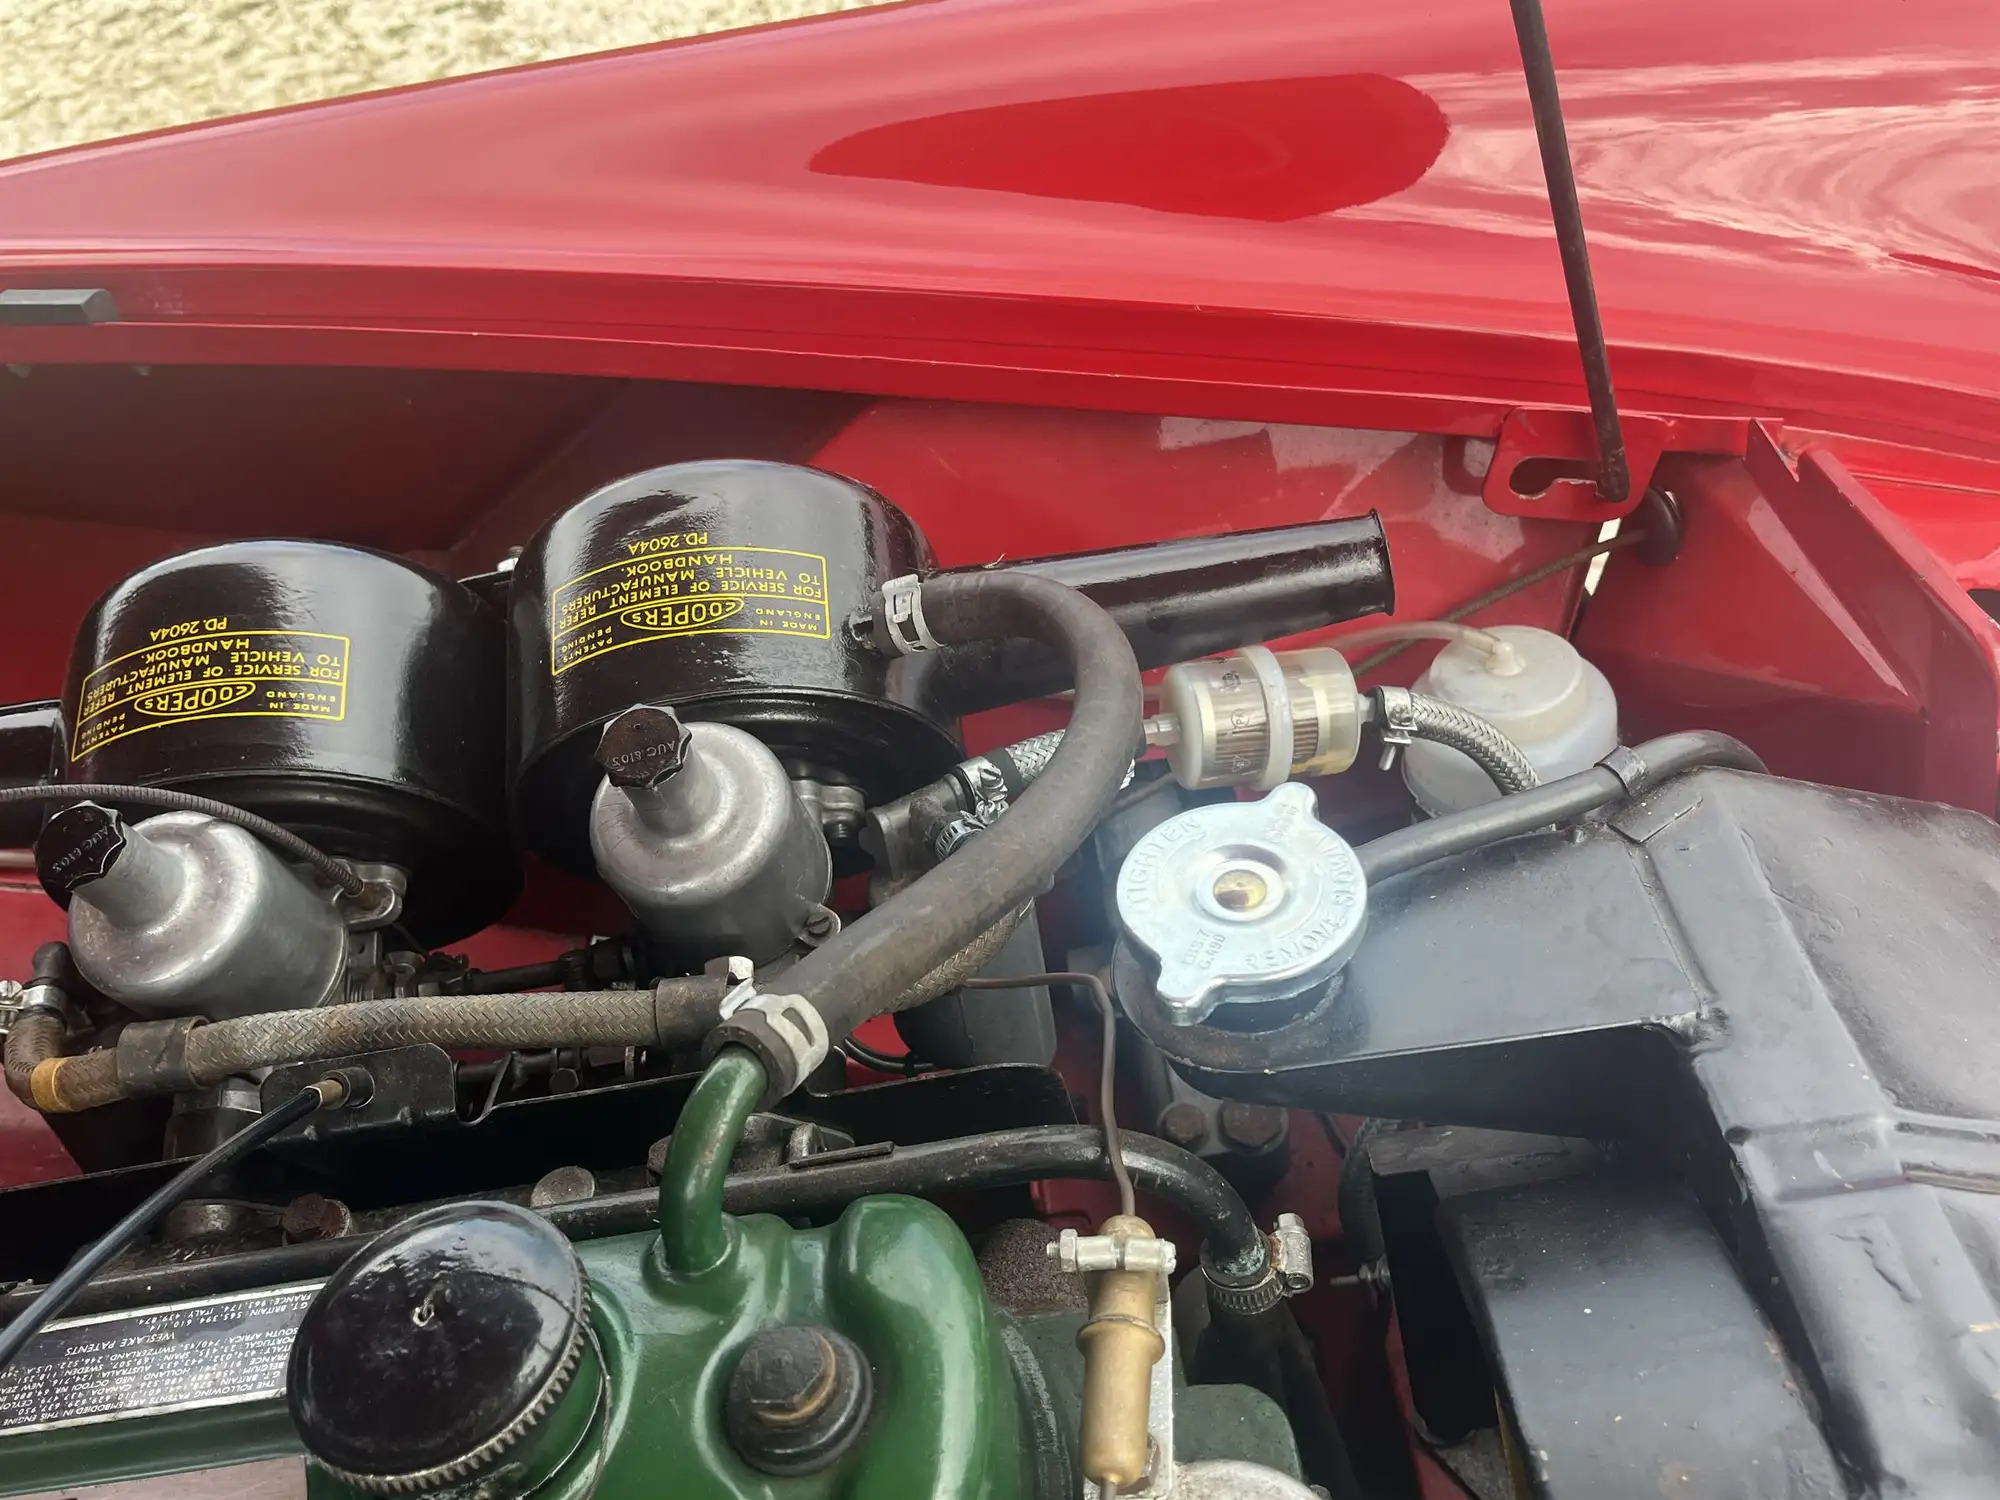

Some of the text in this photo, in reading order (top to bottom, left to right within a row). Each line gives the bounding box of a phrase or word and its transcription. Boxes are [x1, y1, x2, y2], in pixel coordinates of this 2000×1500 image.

[621, 554, 732, 578] HANDBOOK.
[561, 568, 820, 614] TO VEHICLE MANUFACTURERS
[559, 580, 822, 630] FOR SERVICE OF ELEMENT REFER
[756, 608, 820, 620] ENGLAND
[782, 621, 817, 630] MADE
[561, 625, 612, 652] PENDING
[142, 638, 250, 663] HANDBOOK.
[563, 636, 612, 663] PATENTS
[86, 651, 340, 703] TO VEHICLE MANUFACTURERS
[83, 664, 340, 716] FOR SERVICE OF ELEMENT REFER
[266, 690, 336, 702] ENGLAND
[293, 704, 331, 713] MADE
[82, 712, 126, 740] PENDING
[81, 723, 125, 750] PATENTS
[646, 740, 675, 757] AUC
[1126, 819, 1201, 907] TIGHTEN
[1244, 911, 1348, 971] REMOVE
[265, 1326, 298, 1337] SOUTH
[64, 1330, 175, 1356] WESLAKE PATENTS
[22, 1381, 44, 1391] NEW
[72, 1379, 108, 1391] OCTOOI
[193, 1382, 252, 1397] FOLLOWING
[256, 1379, 274, 1388] THE
[124, 1397, 146, 1407] ARE
[148, 1391, 190, 1404] PATENTS
[40, 1410, 58, 1420] THIS
[62, 1408, 74, 1416] IN
[75, 1401, 124, 1414] EMBODIED
